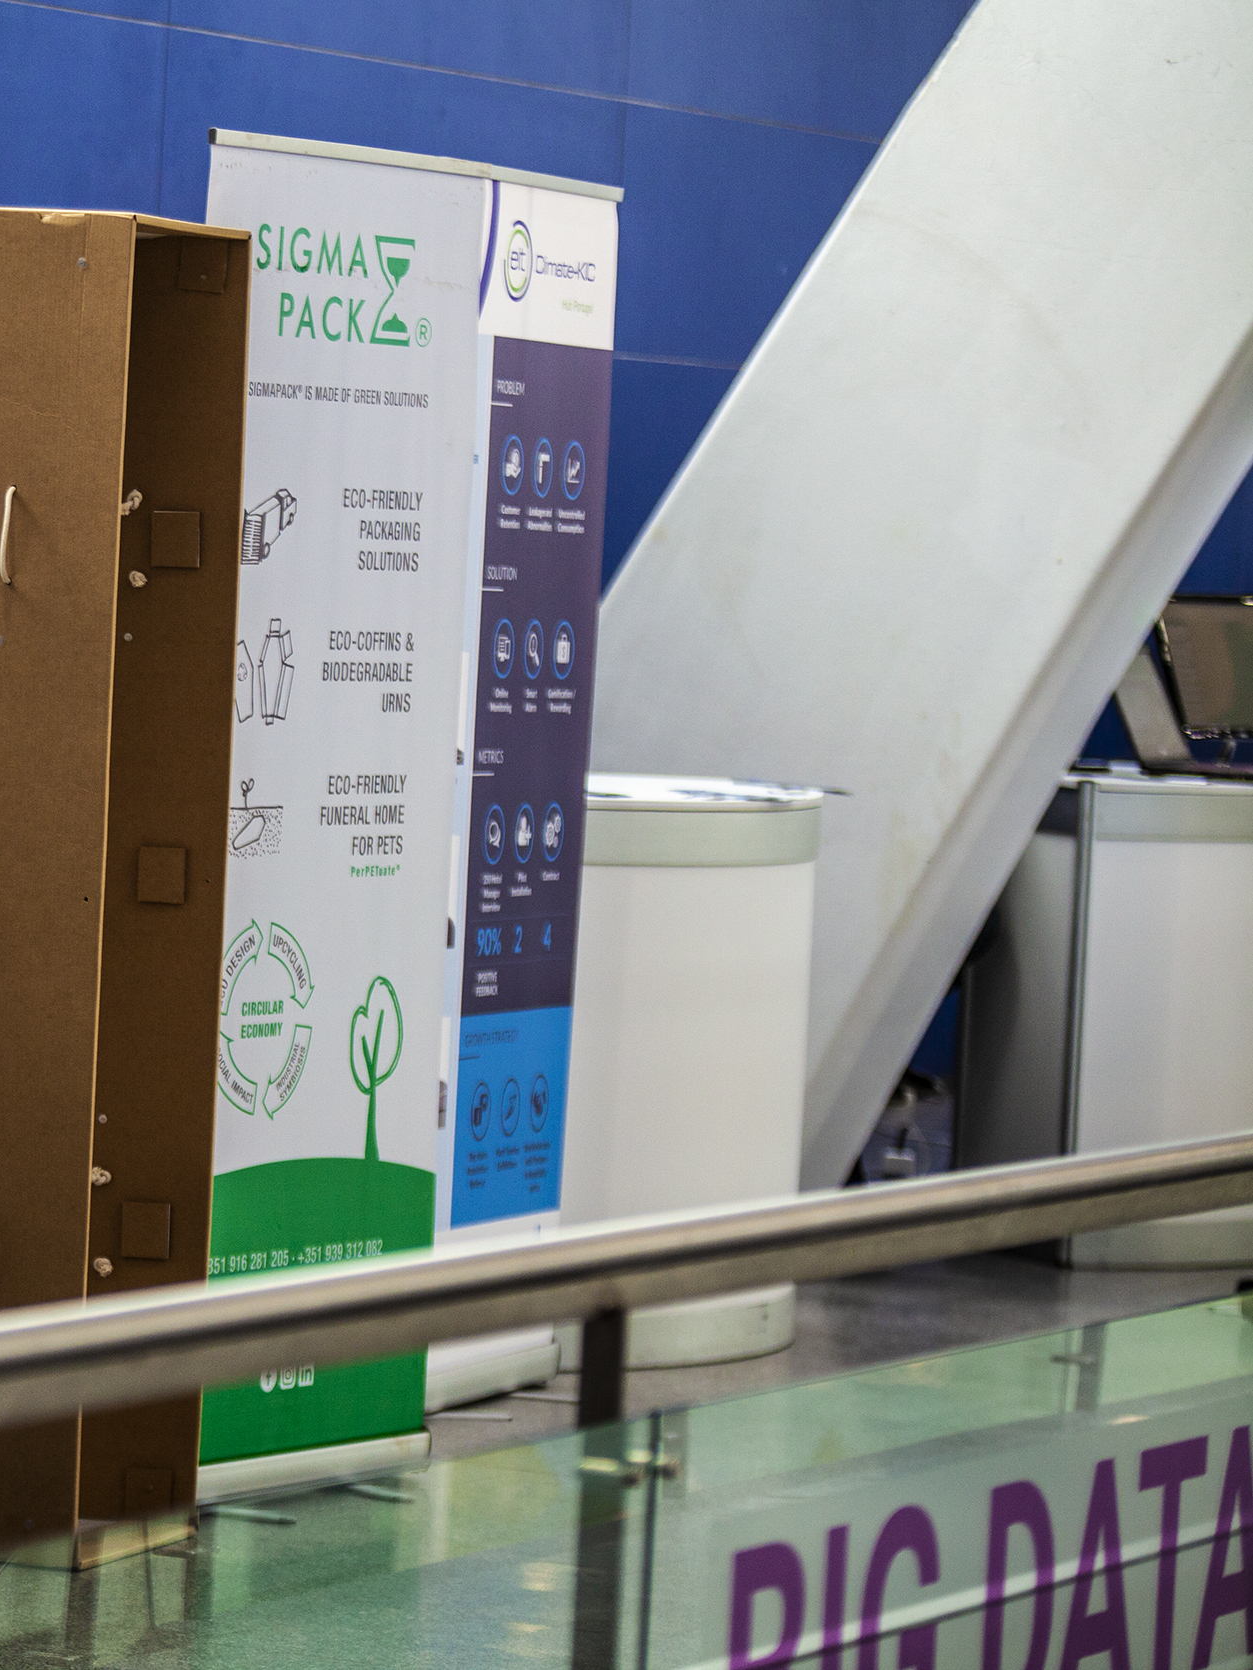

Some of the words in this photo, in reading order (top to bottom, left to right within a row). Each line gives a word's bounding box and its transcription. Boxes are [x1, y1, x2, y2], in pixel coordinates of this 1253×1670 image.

[256, 223, 368, 279] SIGMA
[278, 292, 366, 344] PACK
[305, 385, 312, 400] IS
[315, 386, 339, 403] MADE
[341, 387, 351, 403] OF
[354, 388, 381, 405] GREEN
[384, 390, 429, 409] SOLUTIONS
[497, 379, 525, 396] PROBLEM
[343, 488, 423, 511] ECO-FRIENDLY
[360, 520, 421, 542] PACKAGING
[358, 551, 419, 572] SOLUTIONS
[487, 566, 517, 581] SOLUTION
[329, 630, 401, 651] ECO-COFFINS
[405, 632, 414, 651] &
[322, 661, 413, 682] BIODEGRADABLE
[381, 693, 411, 713] URNS
[478, 751, 504, 764] METRICS
[328, 774, 407, 795] ECO-FRIENDLY
[320, 806, 370, 826] FUNERAL
[375, 805, 405, 825] HOME
[352, 836, 373, 856] FOR
[377, 836, 403, 855] PETS
[477, 927, 502, 957] 90%
[514, 924, 523, 954] 2
[543, 923, 552, 950] 4
[226, 934, 256, 977] DESIGN
[272, 934, 307, 990] UPCYCLING
[241, 1000, 284, 1017] CIRCULAR
[241, 1022, 283, 1039] ECONOMY
[218, 1050, 231, 1084] OCIAL
[231, 1079, 254, 1105] IMPACT
[279, 1046, 306, 1101] SYMBIOSIS
[230, 1254, 248, 1273] 916
[250, 1252, 267, 1270] 281
[271, 1250, 289, 1268] 205
[298, 1246, 322, 1264] +351
[325, 1243, 344, 1261] 939
[346, 1241, 364, 1259] 312
[366, 1239, 383, 1257] 082
[980, 1424, 1253, 1670] DATA
